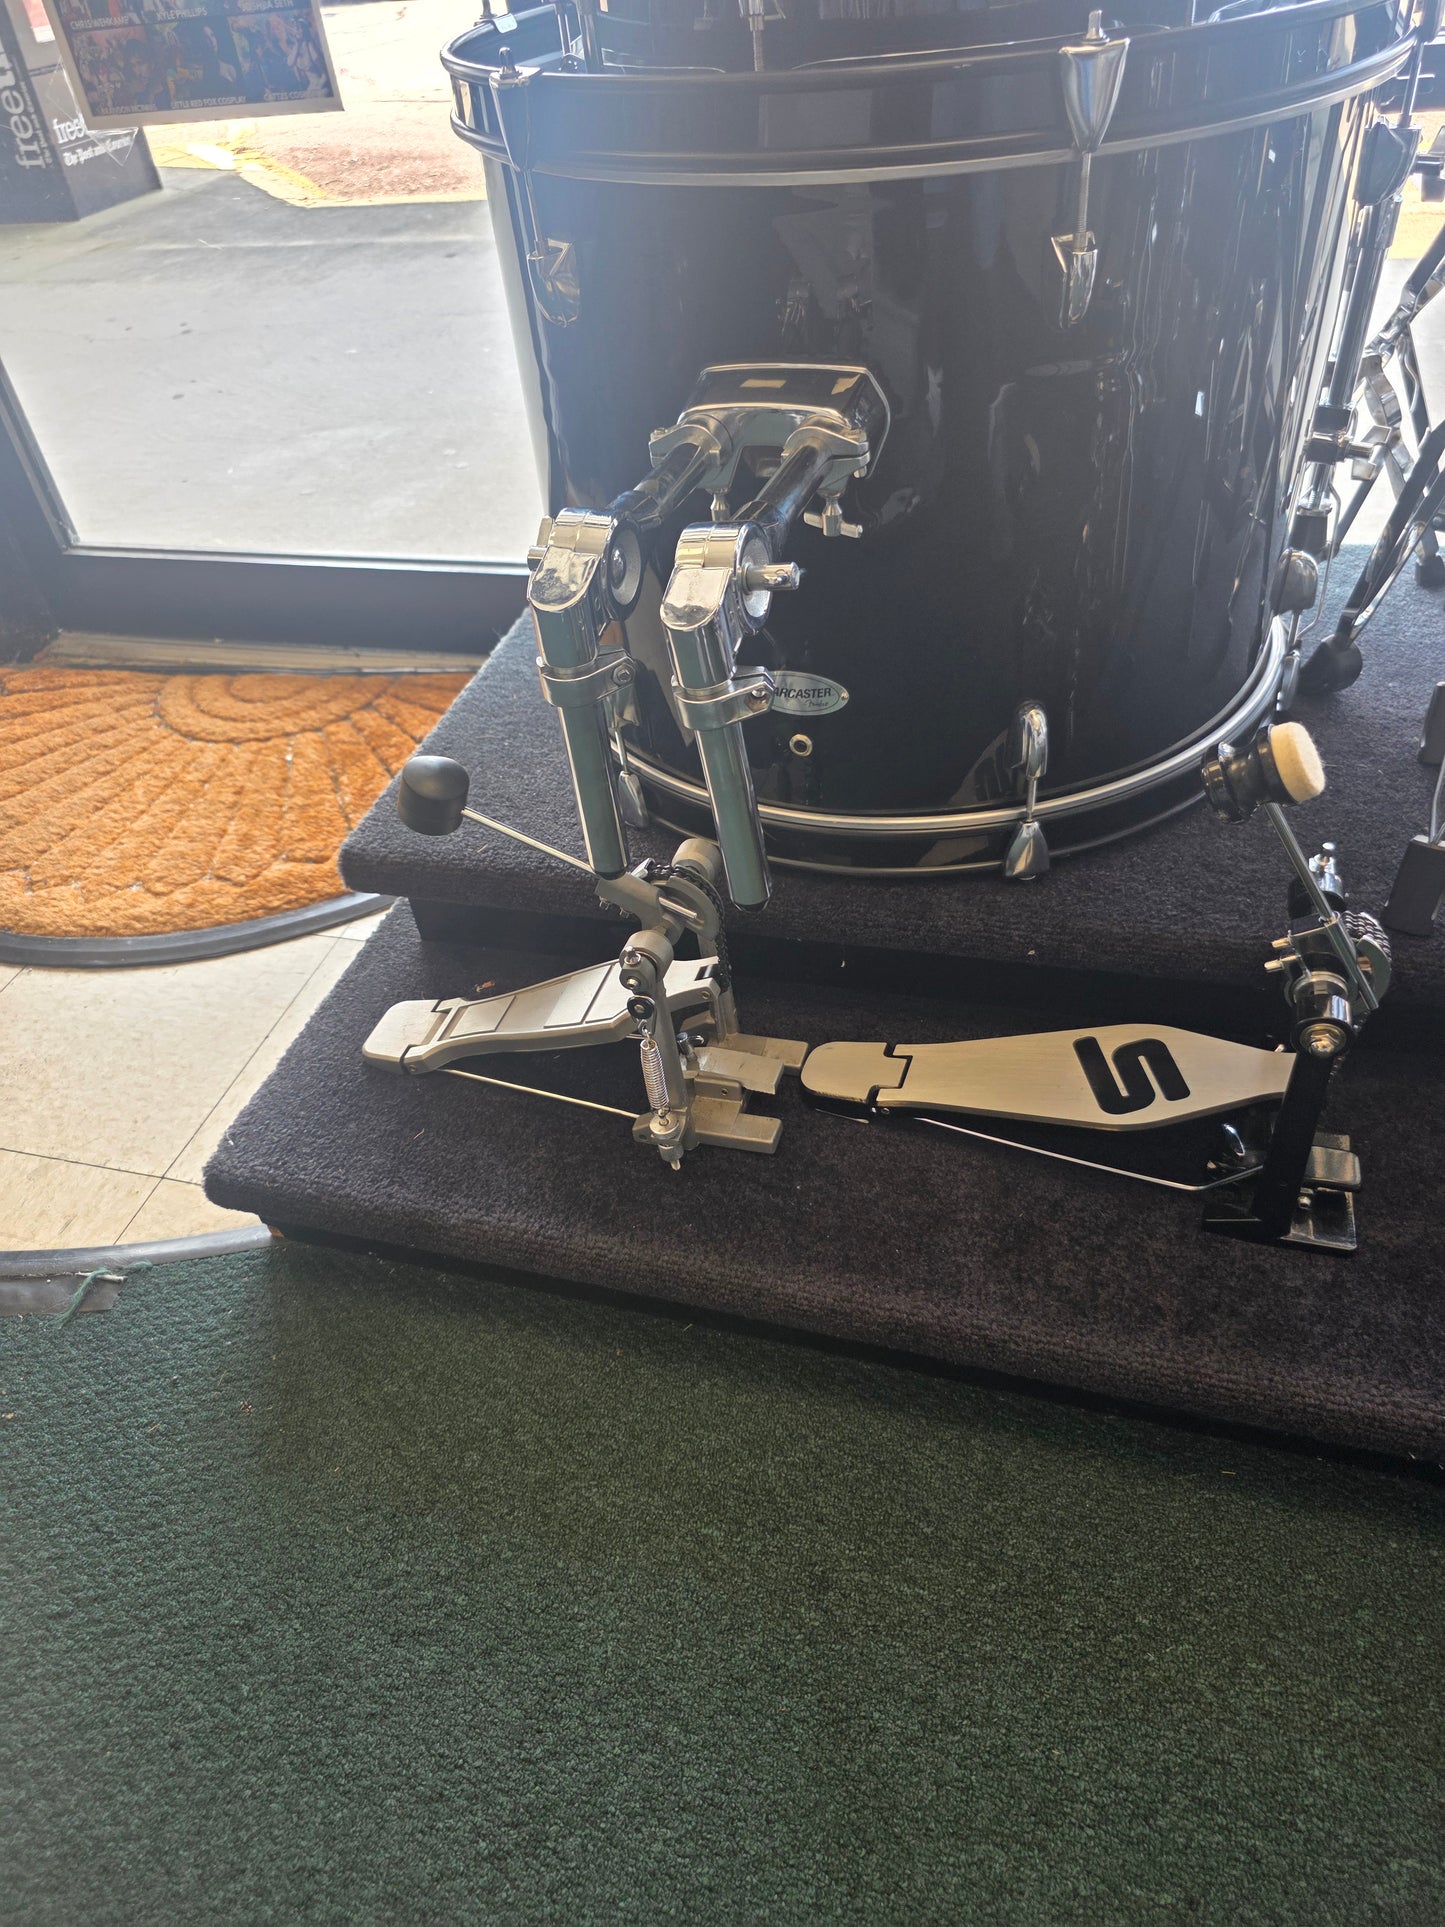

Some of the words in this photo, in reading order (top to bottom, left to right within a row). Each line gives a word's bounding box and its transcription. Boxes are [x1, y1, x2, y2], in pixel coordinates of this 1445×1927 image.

[203, 96, 217, 106] FOX
[217, 95, 247, 105] COSPLAY
[773, 687, 831, 699] ARCASTER
